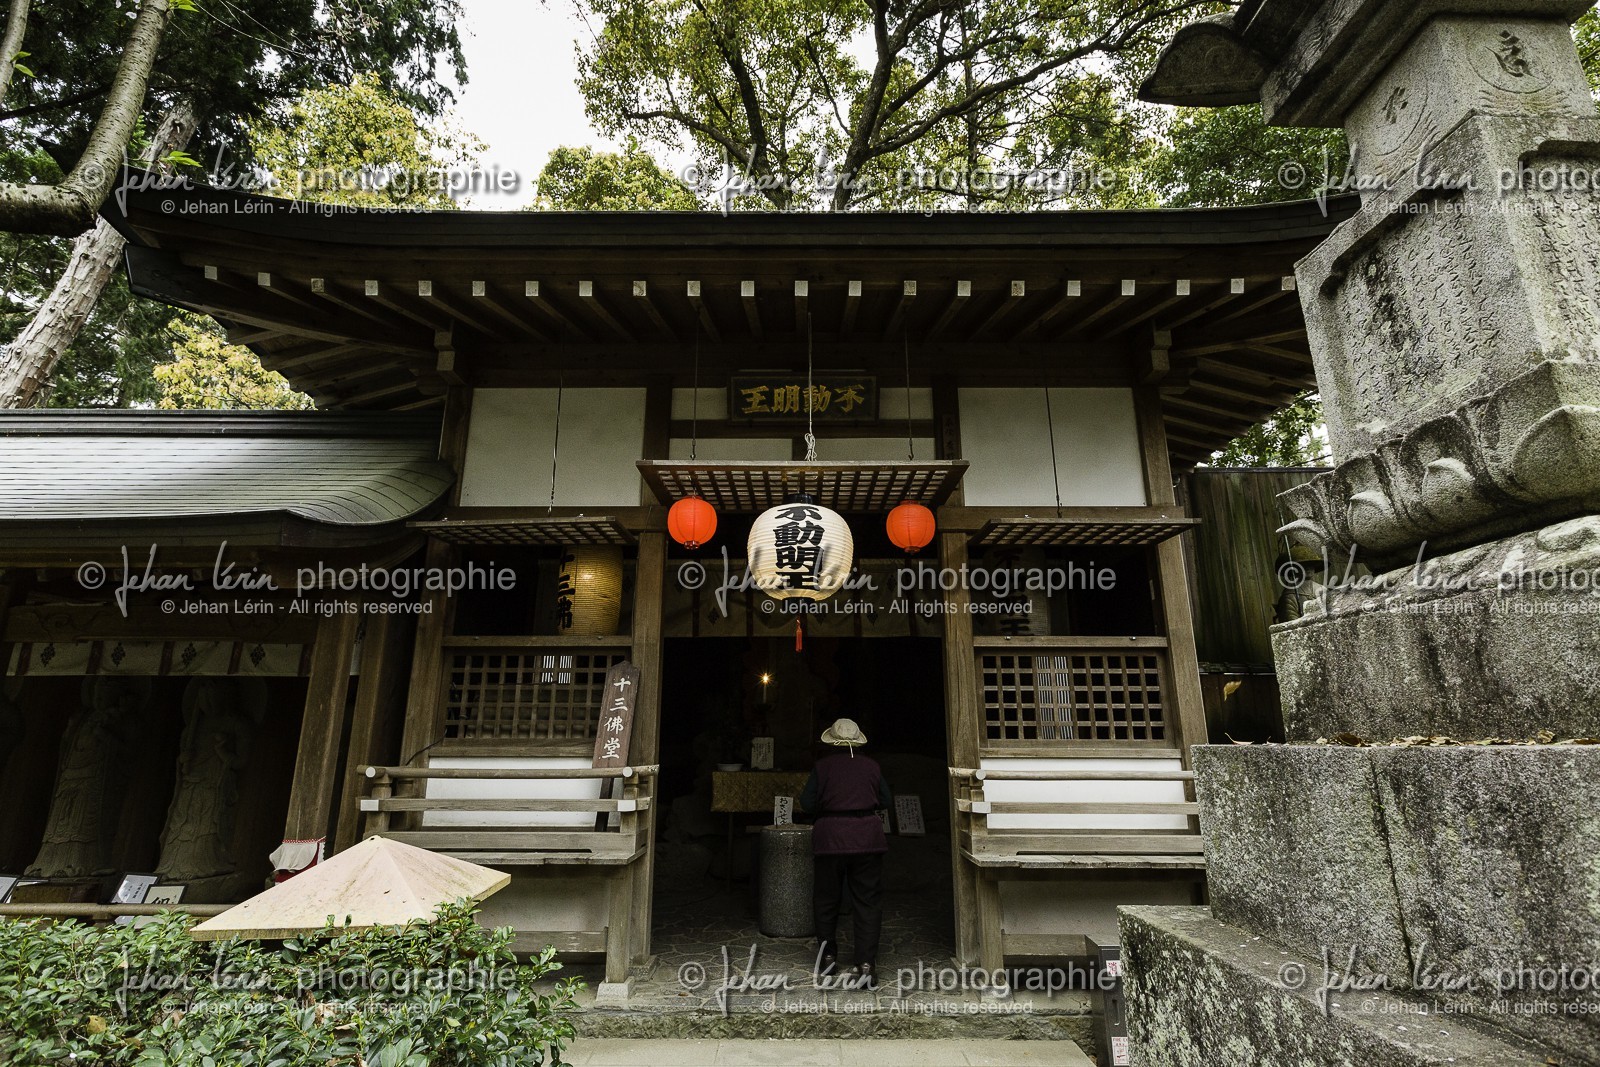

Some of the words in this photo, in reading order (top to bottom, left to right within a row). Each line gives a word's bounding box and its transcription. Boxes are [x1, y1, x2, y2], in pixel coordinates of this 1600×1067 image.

[773, 506, 825, 592] 不動明王
[602, 677, 631, 759] 十三佛堂
